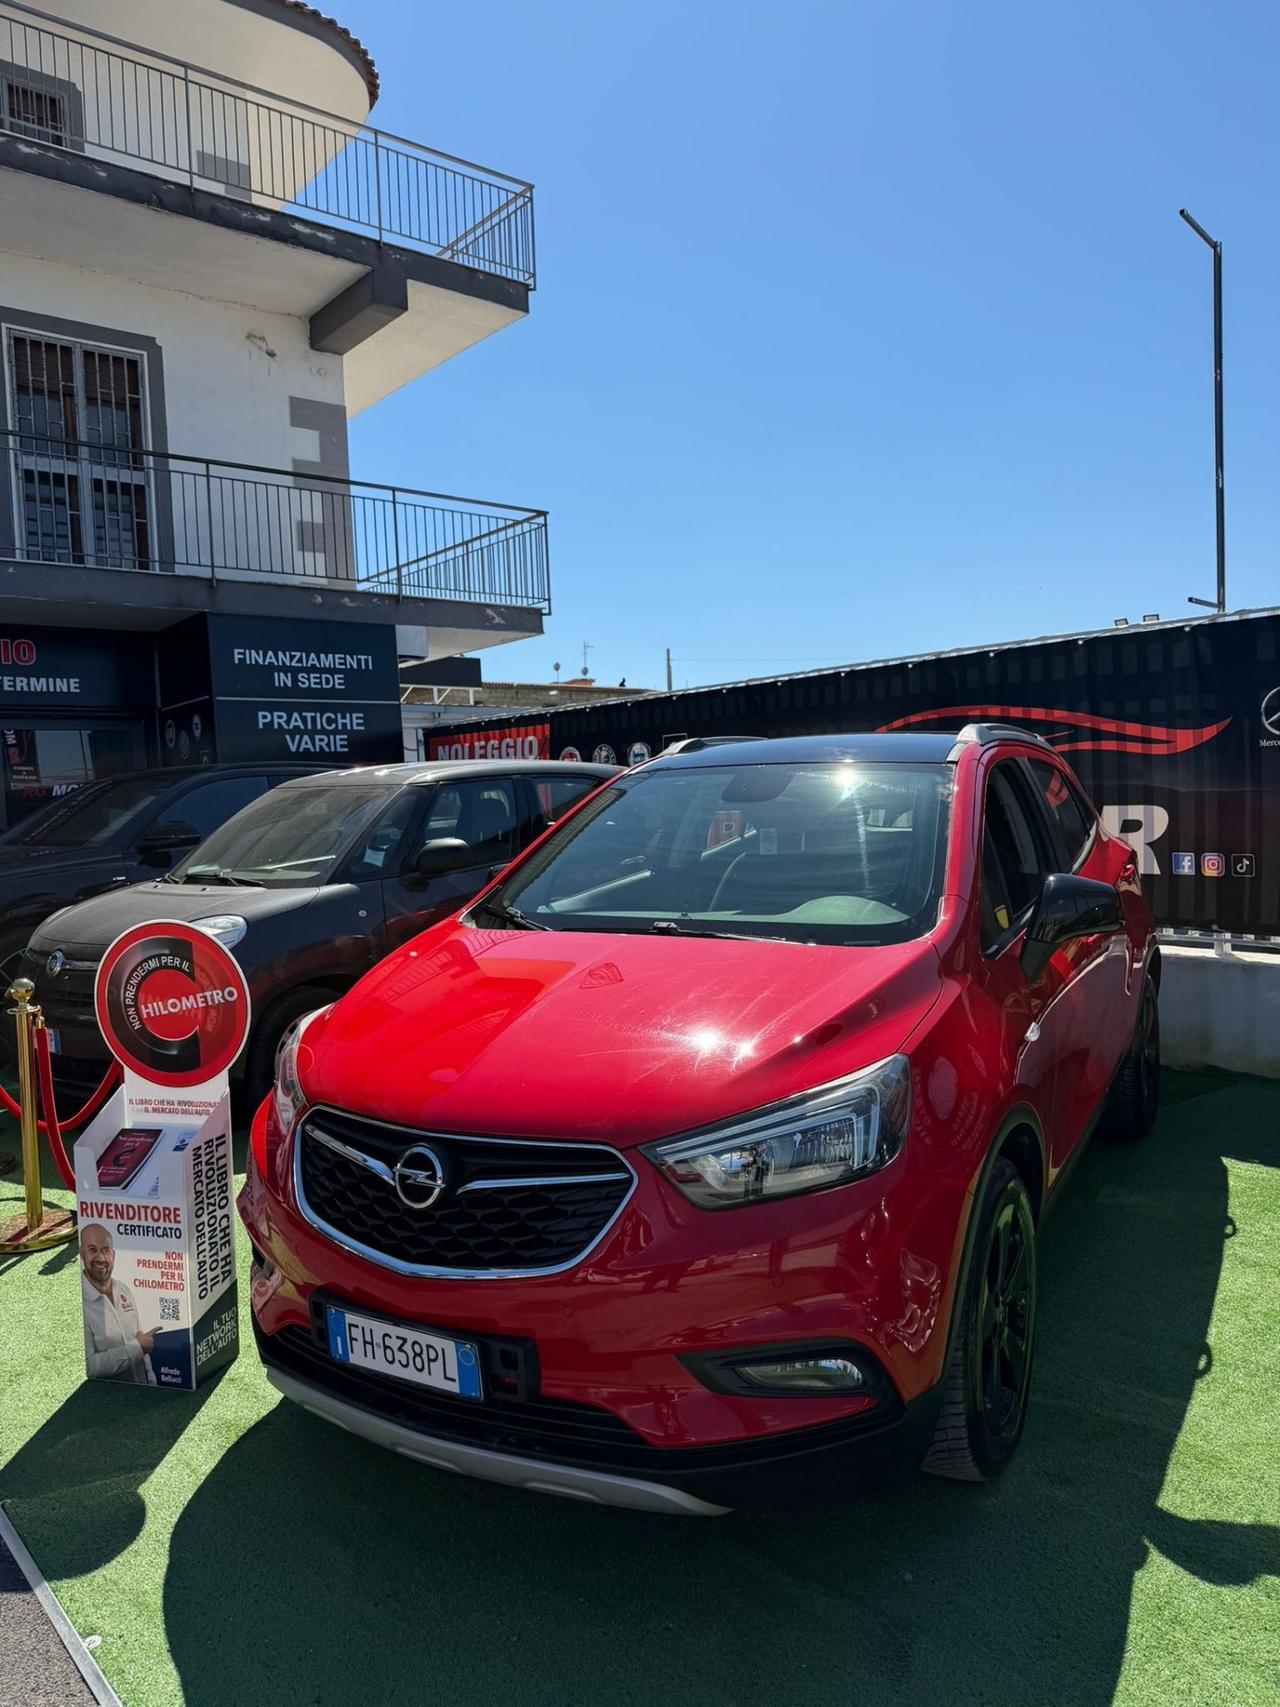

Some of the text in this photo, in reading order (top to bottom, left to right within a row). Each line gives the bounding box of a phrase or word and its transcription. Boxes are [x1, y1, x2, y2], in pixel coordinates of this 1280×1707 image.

[233, 648, 373, 670] FINANZIAMENTI
[0, 676, 81, 693] ERMINE
[274, 671, 346, 689] IN SEDE
[258, 711, 365, 730] PRATICHE
[285, 733, 348, 752] VARIE
[437, 735, 540, 760] NOLEGGIO
[126, 956, 190, 1030] NON PRENDERMI PER IL
[152, 1107, 179, 1115] MERCATO
[180, 1108, 210, 1116] DELL'AUTO
[80, 1201, 181, 1224] RIVENDITORE
[204, 1138, 220, 1292] RIVOLUZIONATO IL
[215, 1133, 232, 1284] IL LIBRO CHE HA
[117, 1223, 182, 1239] CERTIFICATO
[192, 1145, 209, 1300] MERCATO DELL'AUTO
[136, 1259, 184, 1271] PRENDERMI
[165, 1251, 183, 1261] NON
[133, 1279, 184, 1292] CHILOMETRO
[160, 1270, 184, 1281] PER IL
[213, 1306, 237, 1331] IL TUO
[196, 1320, 237, 1355] NETWORK
[196, 1328, 237, 1365] DELL'AUTO
